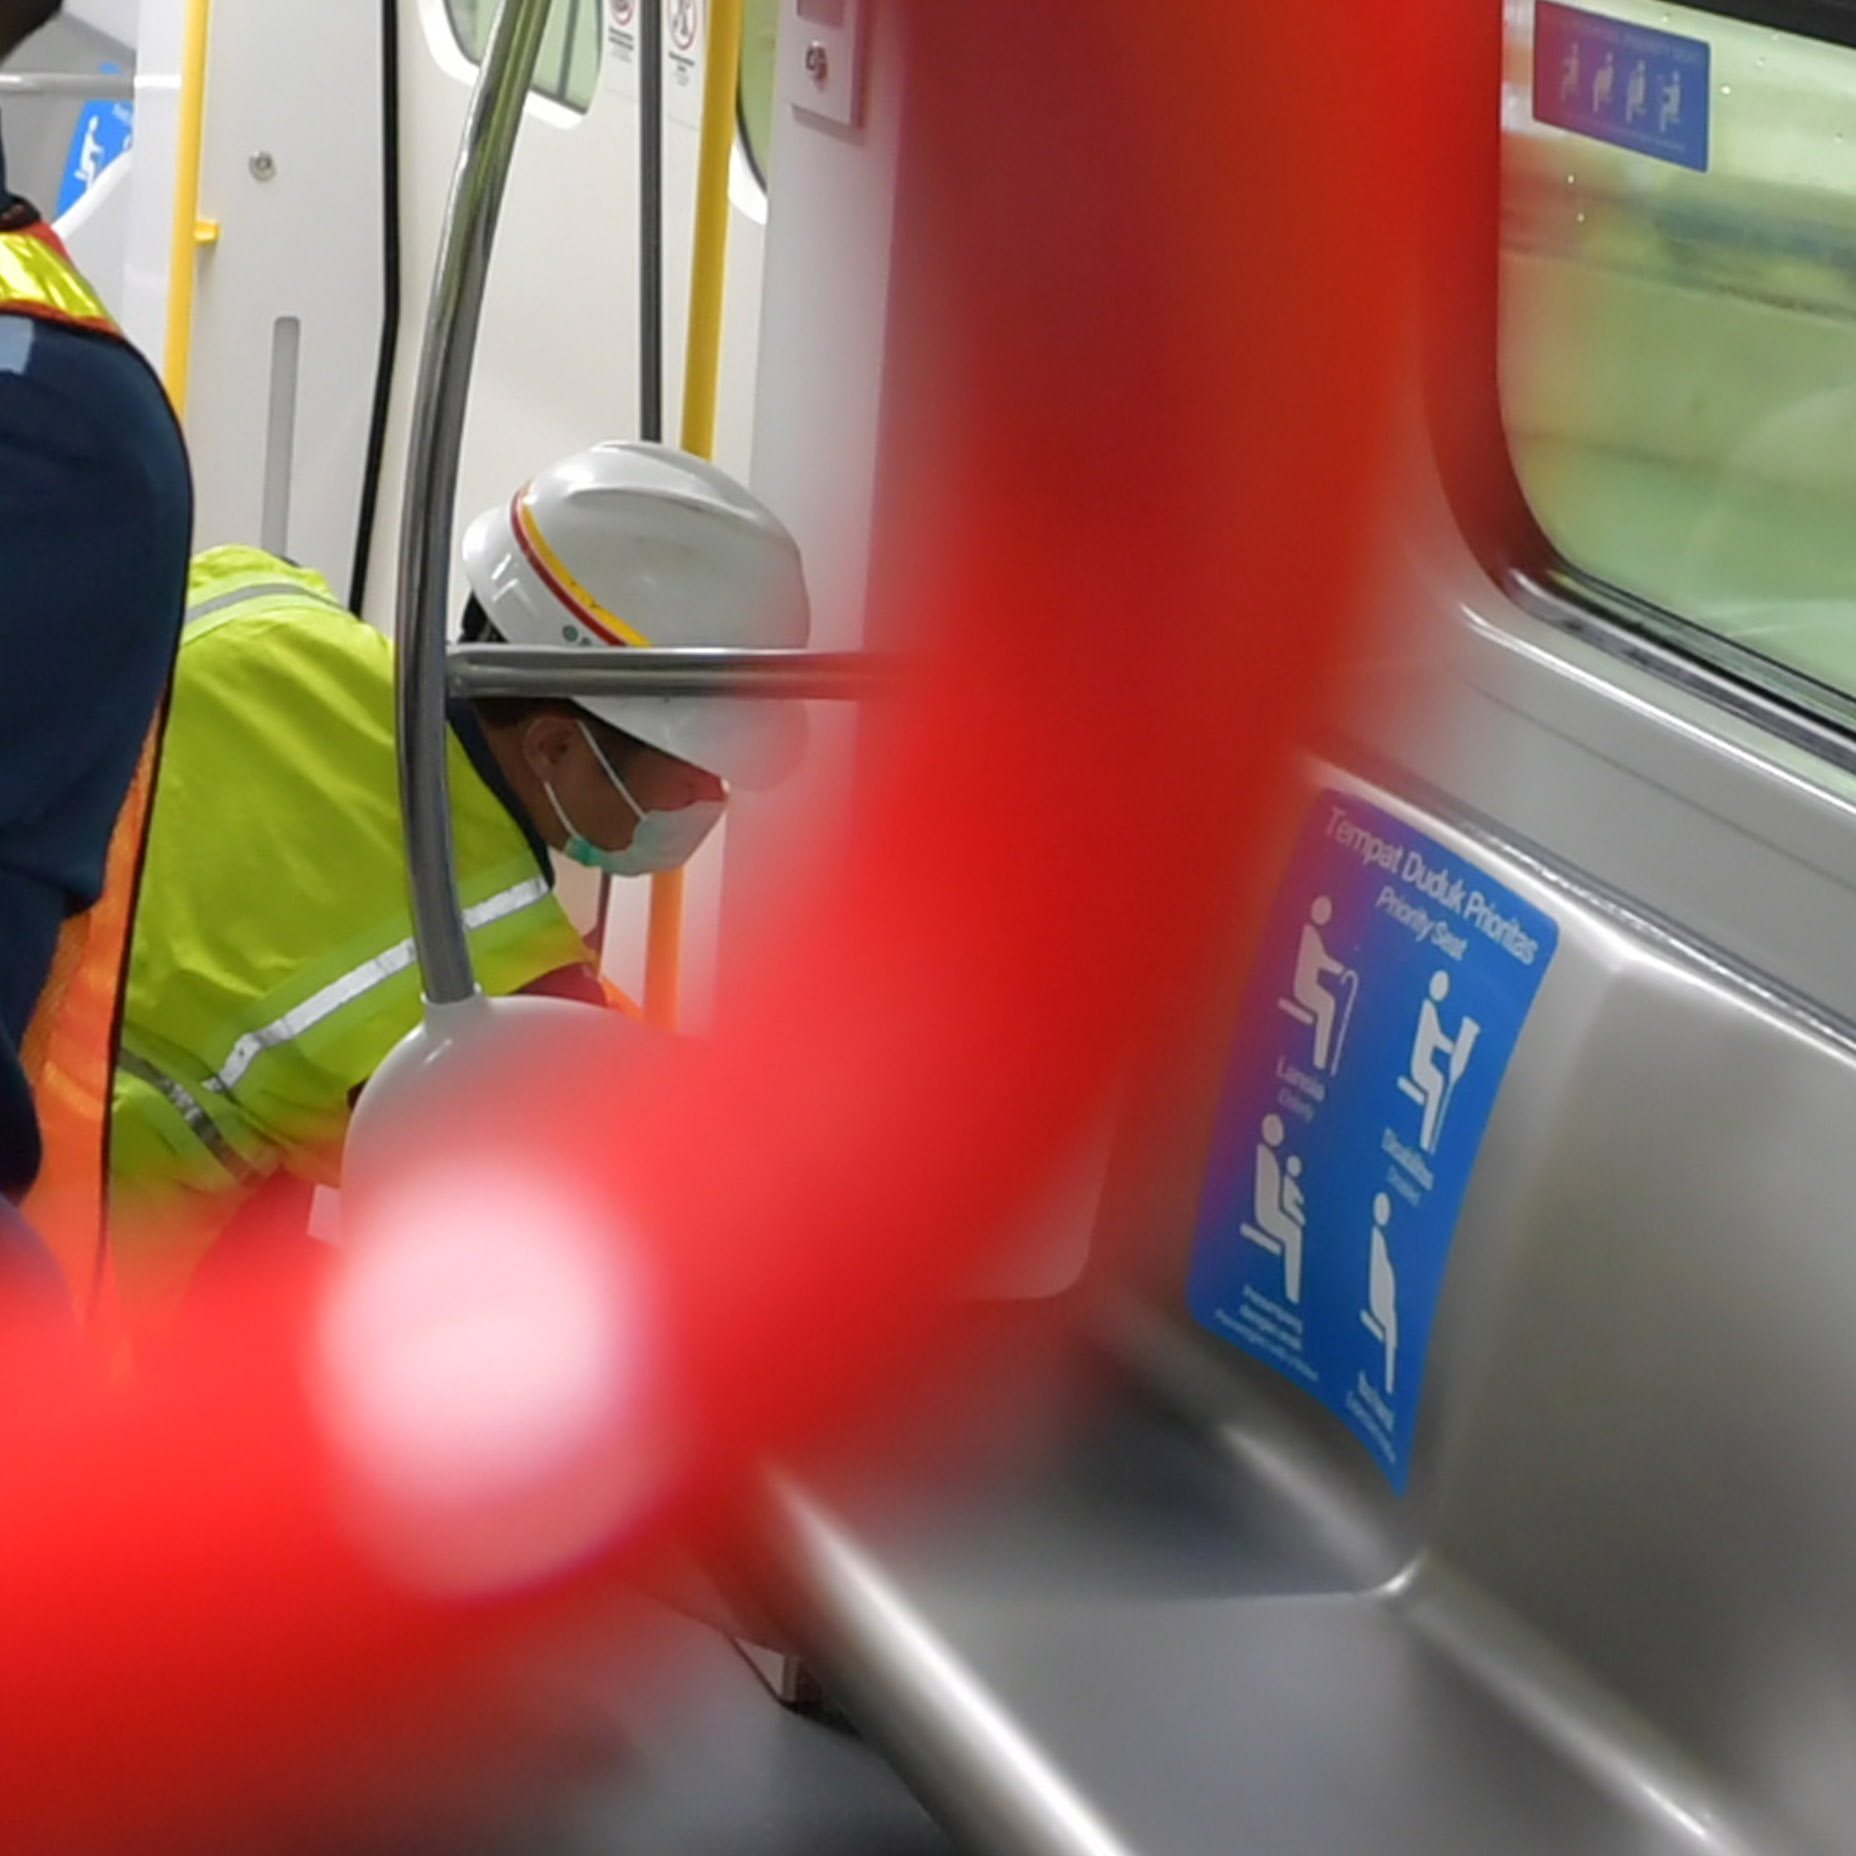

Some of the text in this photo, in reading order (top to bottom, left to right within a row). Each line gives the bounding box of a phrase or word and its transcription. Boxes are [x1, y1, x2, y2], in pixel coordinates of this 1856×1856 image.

[1324, 806, 1540, 966] Tempat Duduk Prioritas
[1376, 885, 1469, 961] Priority Seat
